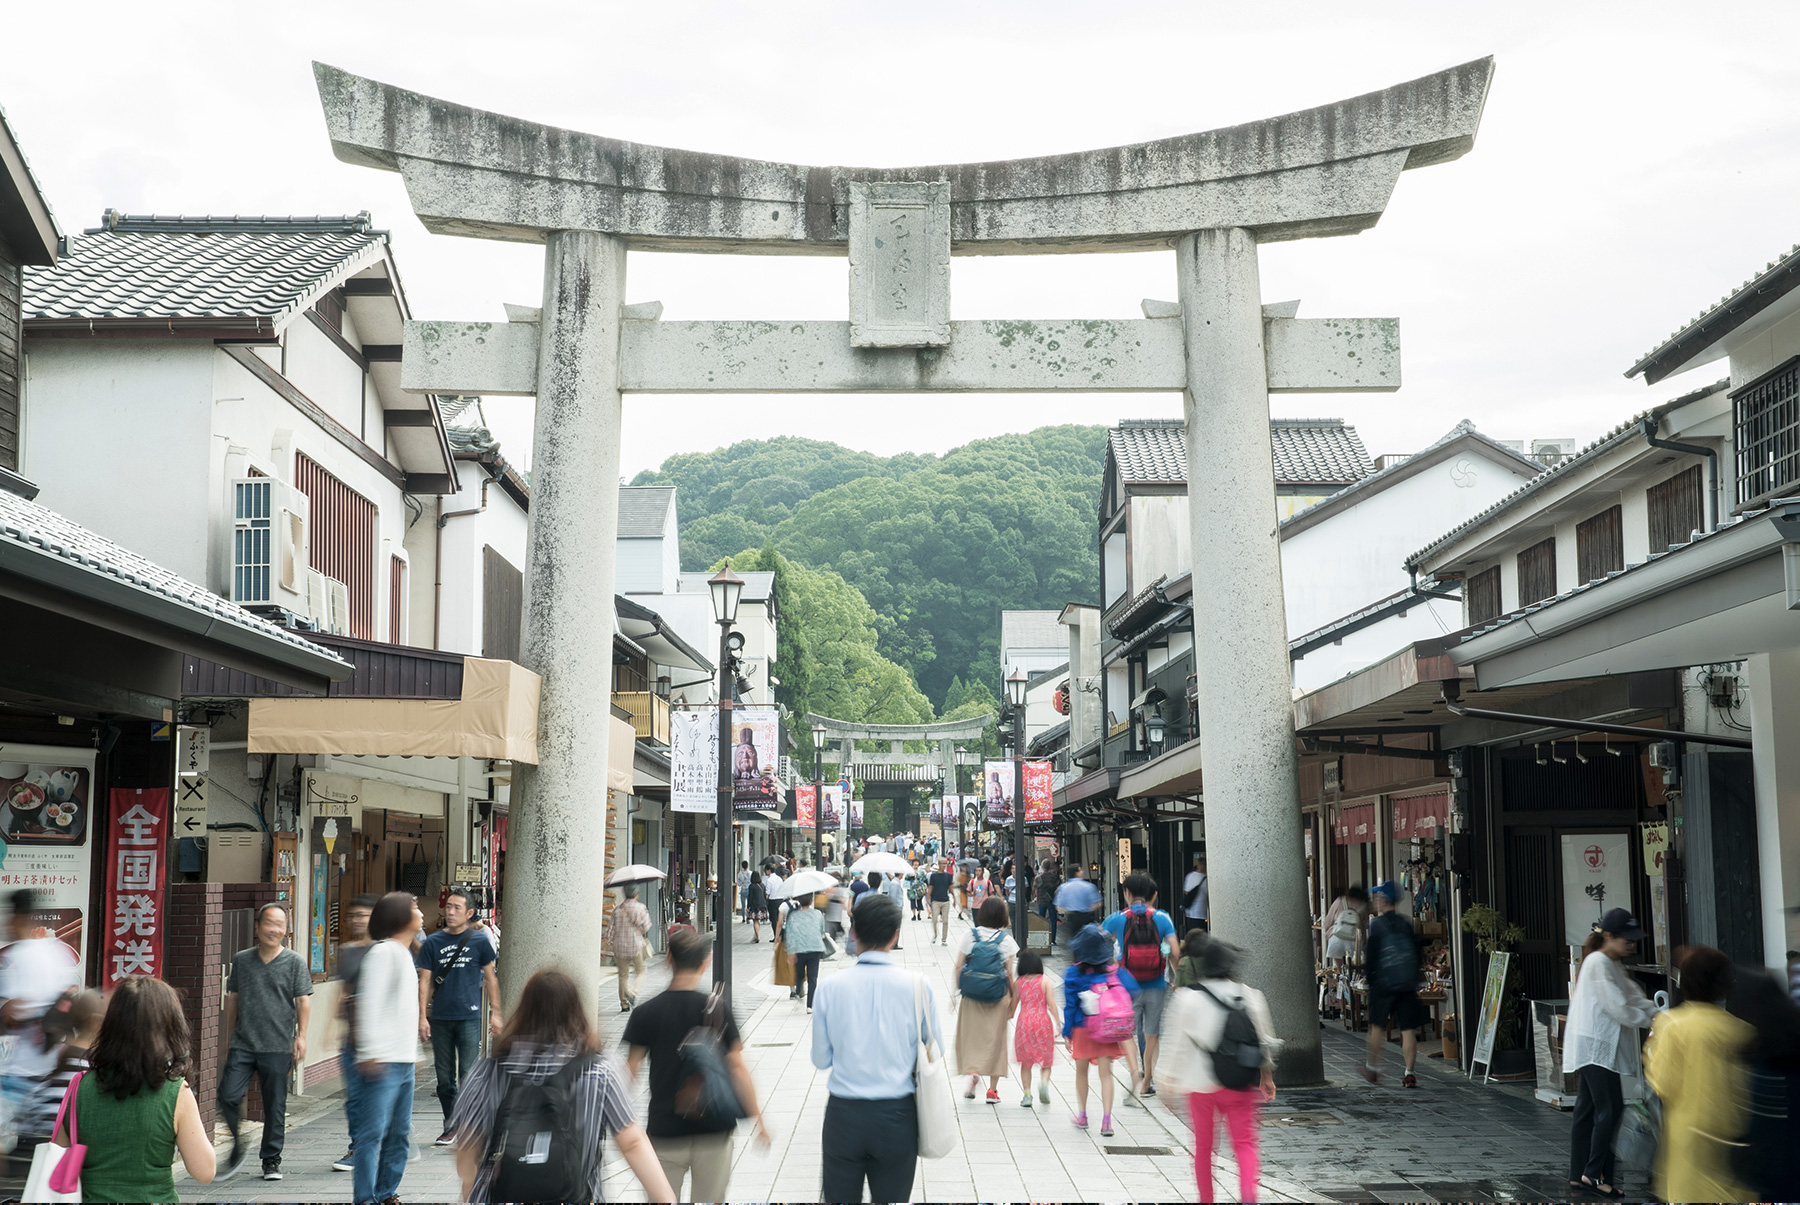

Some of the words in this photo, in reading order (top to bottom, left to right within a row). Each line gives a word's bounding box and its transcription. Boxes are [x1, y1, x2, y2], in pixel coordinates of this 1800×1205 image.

[189, 742, 199, 770] ふくや
[1, 874, 78, 886] 明太子茶漬けセット
[110, 804, 161, 982] 全国発送
